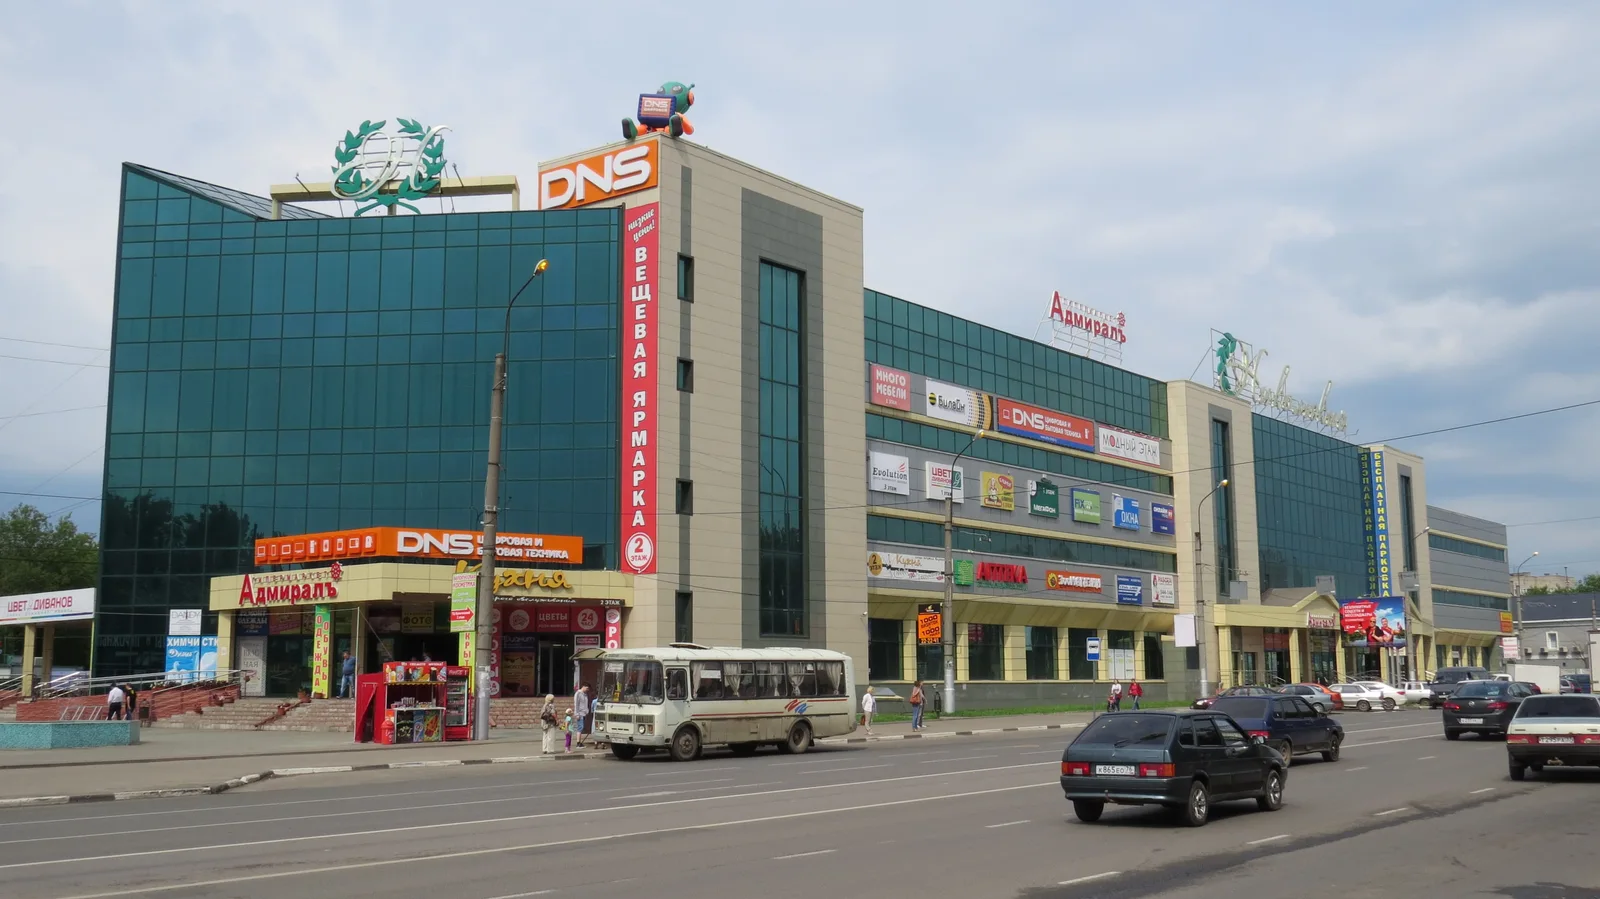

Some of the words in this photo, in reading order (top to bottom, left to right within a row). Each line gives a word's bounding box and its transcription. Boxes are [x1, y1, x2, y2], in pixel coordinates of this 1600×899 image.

[644, 100, 668, 108] DNS
[540, 144, 651, 209] DNS
[628, 208, 655, 232] низкие
[633, 219, 656, 243] цены!
[631, 246, 652, 379] ВЕЩЕВАЯ
[1049, 290, 1127, 343] Адмиралъ
[876, 369, 906, 387] МНОГО
[876, 382, 907, 400] МЕБЕЛИ
[938, 394, 965, 412] Билайн
[1012, 408, 1045, 431] DNS
[1064, 429, 1082, 439] ТЕХНИКА
[1102, 433, 1136, 451] МОДНЫЙ
[1138, 442, 1158, 458] ЭТАЖ
[631, 390, 647, 527] ЯРМАРКА
[872, 466, 908, 481] Evolution
[931, 467, 952, 478] ЦВЕТ
[1374, 452, 1386, 530] БЕСПЛАТНАЯ
[1121, 511, 1139, 525] ОКНА
[397, 531, 473, 555] DNS
[534, 538, 543, 548] И
[634, 537, 644, 553] 2
[525, 550, 569, 560] ТЕХНИКА
[631, 554, 648, 562] ЭТАЖ
[872, 554, 877, 564] 2
[976, 562, 1028, 584] АПТЕКА
[238, 573, 337, 605] Адмиралъ
[8, 601, 27, 612] ЦВЕТ
[33, 596, 73, 610] ДИВАНОВ
[538, 613, 568, 622] ЦВЕТЫ
[581, 612, 594, 622] 24
[920, 614, 938, 623] 1000
[922, 626, 939, 636] 1000
[314, 615, 323, 687] ОДЕЖДА
[322, 621, 330, 681] ОБУВЬ
[1097, 765, 1125, 774] К865ЕО
